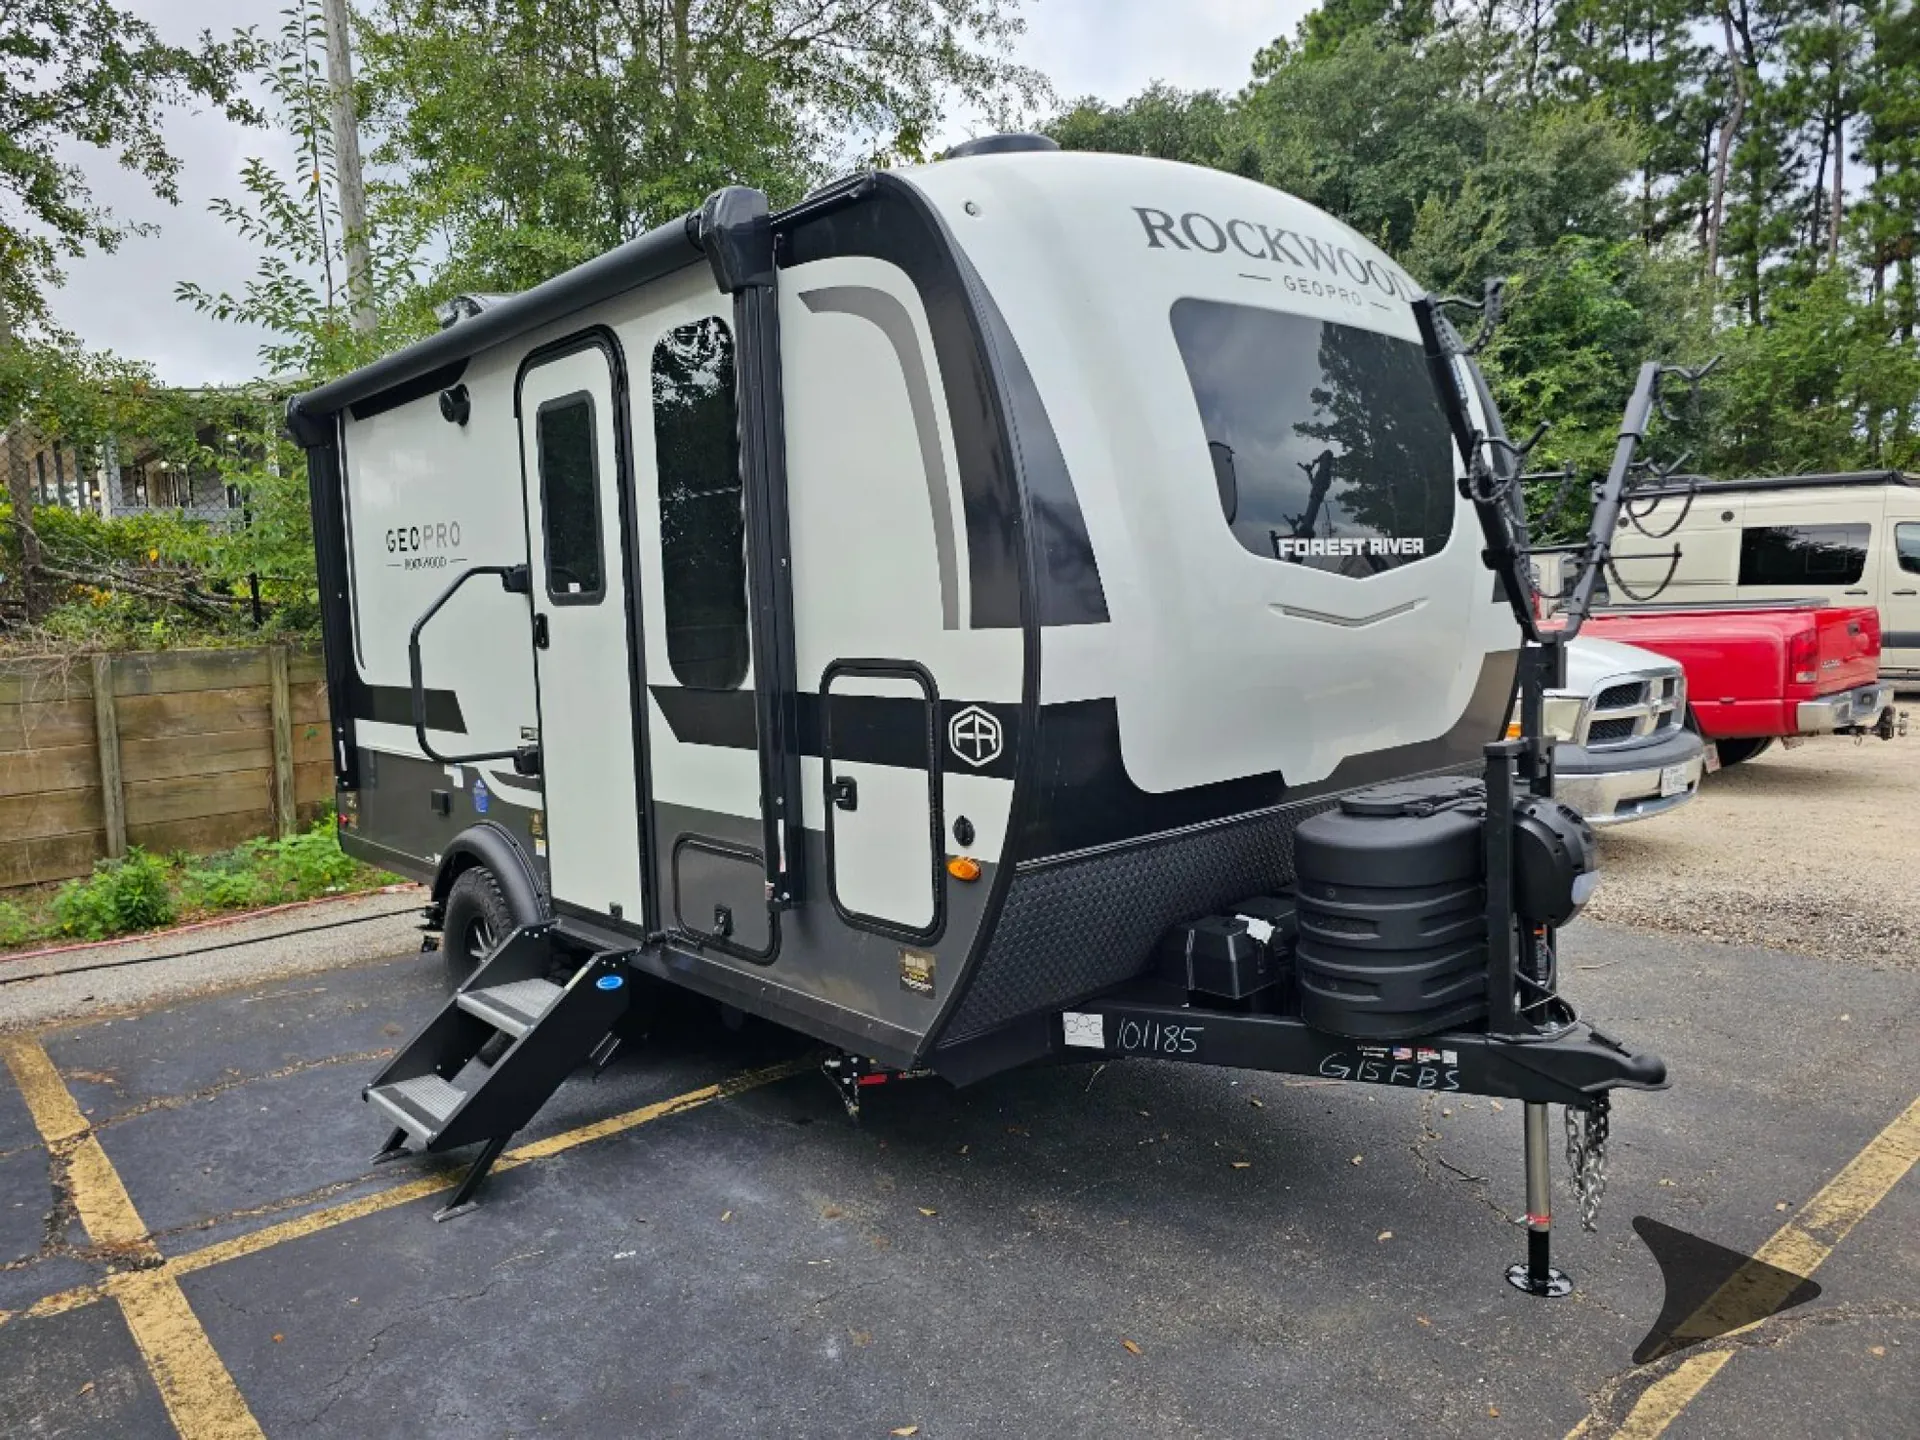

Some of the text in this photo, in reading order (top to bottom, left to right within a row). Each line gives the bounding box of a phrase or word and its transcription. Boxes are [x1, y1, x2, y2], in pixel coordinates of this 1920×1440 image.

[1283, 274, 1362, 306] GEOPRO
[385, 520, 461, 553] GEOPRO
[1277, 537, 1424, 558] FOREST RIVER
[1116, 1016, 1205, 1053] 101185
